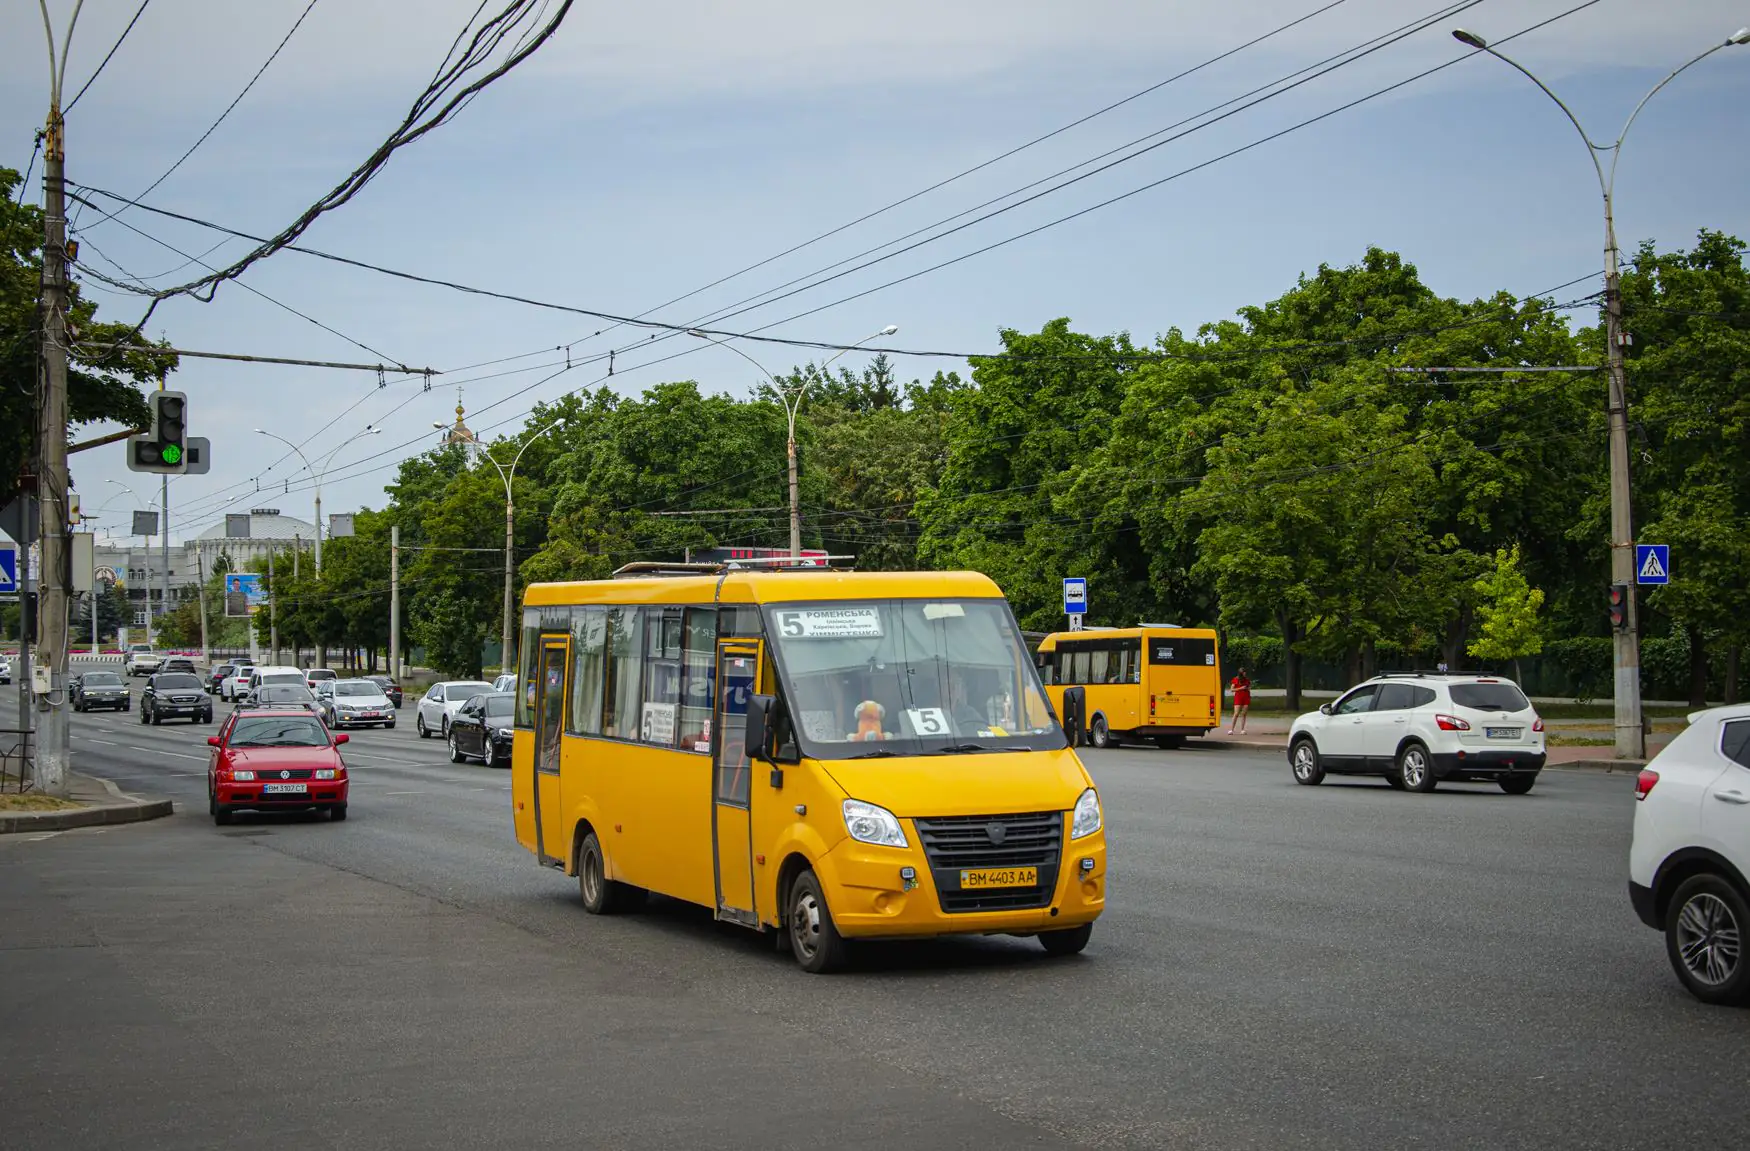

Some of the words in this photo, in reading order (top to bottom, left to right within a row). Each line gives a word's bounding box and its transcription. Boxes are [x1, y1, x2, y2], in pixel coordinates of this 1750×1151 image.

[782, 613, 804, 636] 5
[806, 609, 873, 618] РОМЕНСЬКА
[643, 710, 653, 740] 5
[919, 710, 941, 732] 5
[969, 872, 987, 886] BM
[989, 871, 1015, 884] 4403
[1018, 871, 1036, 883] AA
